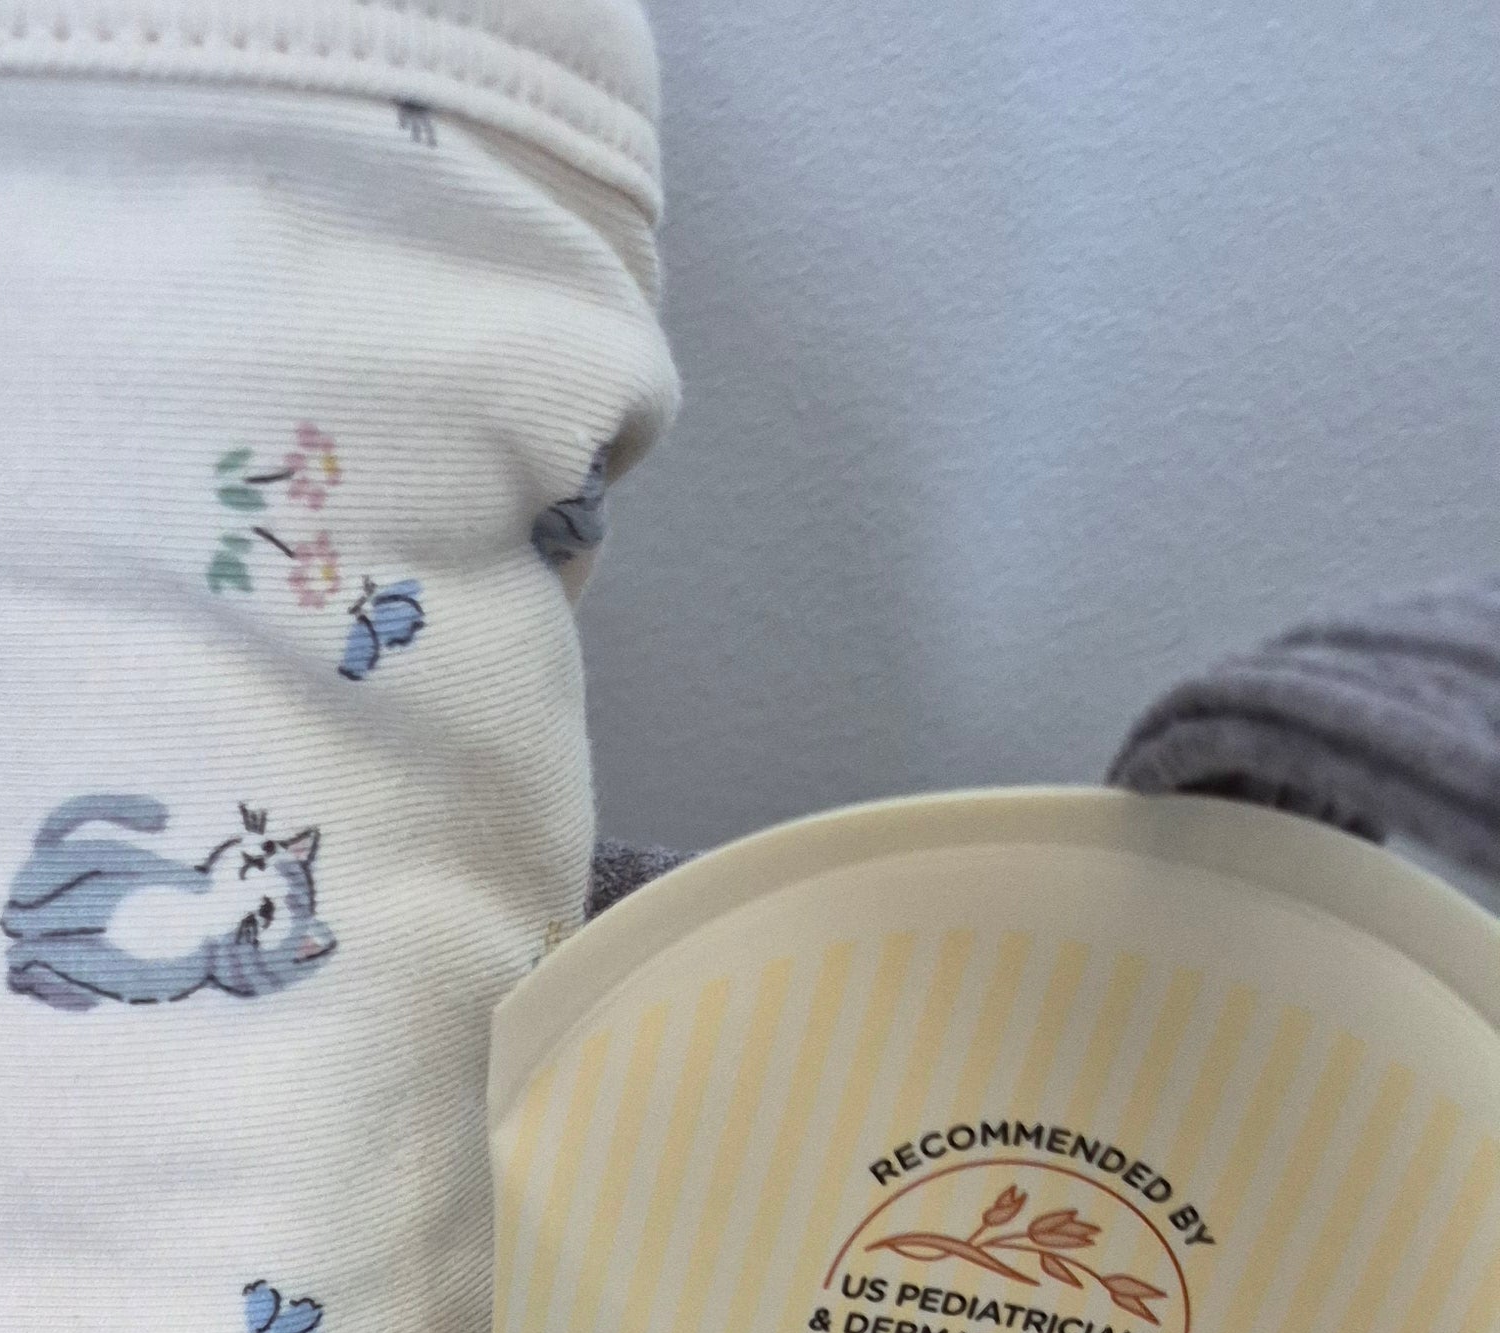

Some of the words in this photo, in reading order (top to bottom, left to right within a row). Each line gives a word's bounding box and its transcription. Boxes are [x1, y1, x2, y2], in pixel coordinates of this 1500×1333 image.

[869, 1120, 1172, 1204] RECOMMENDED
[1168, 1204, 1217, 1247] BY
[841, 1273, 888, 1302] US
[808, 1307, 831, 1333] &
